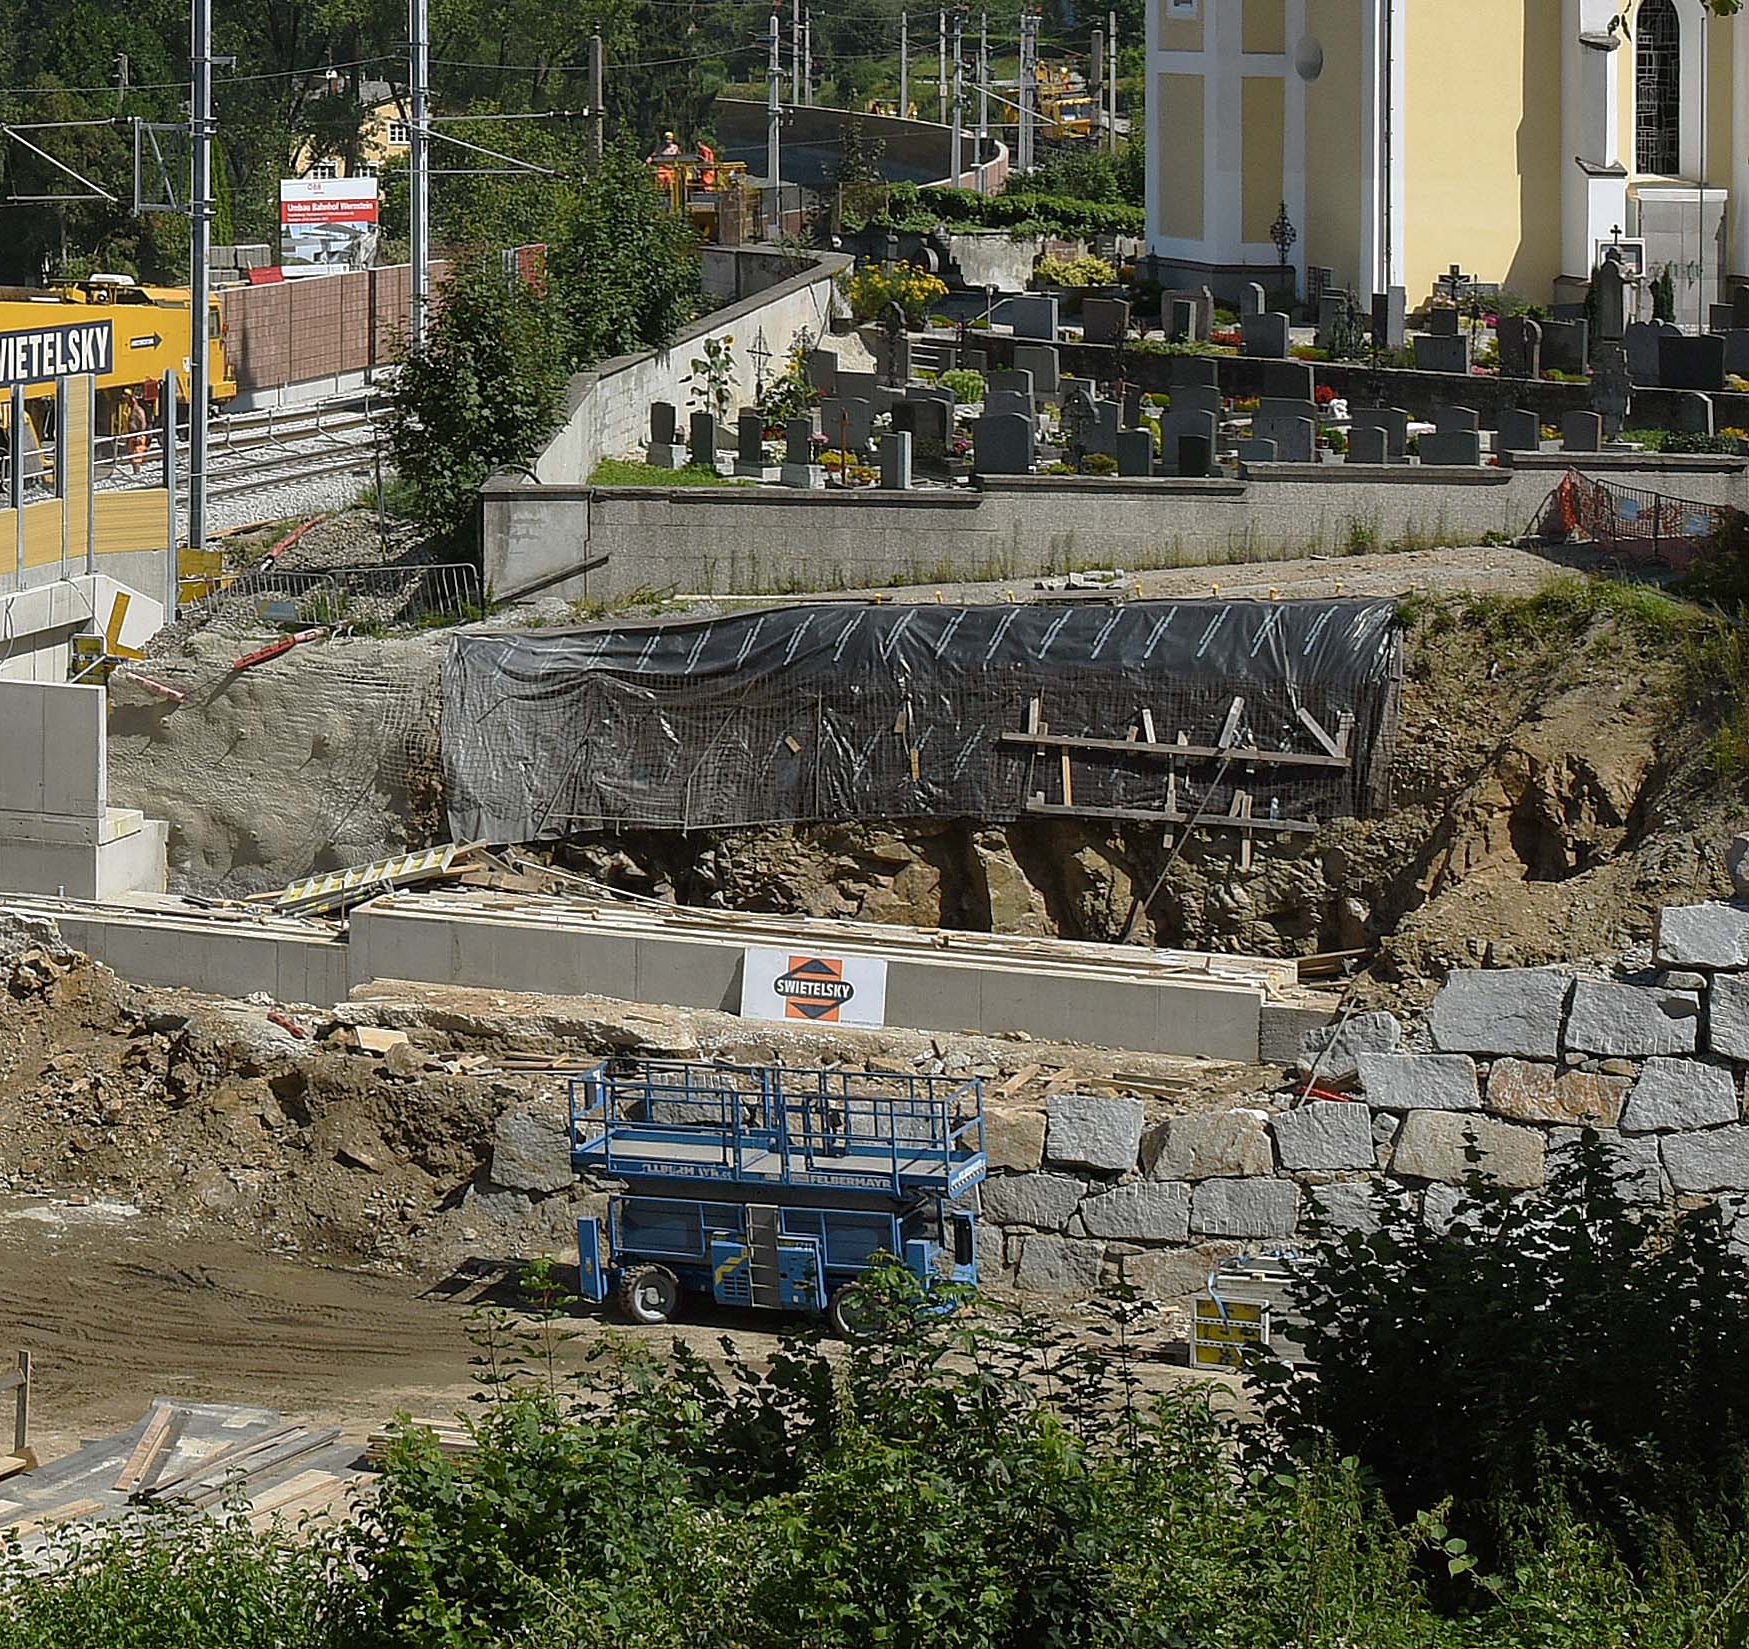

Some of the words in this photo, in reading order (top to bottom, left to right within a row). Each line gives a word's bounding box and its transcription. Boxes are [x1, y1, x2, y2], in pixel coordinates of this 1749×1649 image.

[287, 203, 310, 212] Umbau
[312, 202, 339, 211] Bahnhof
[776, 979, 850, 998] SWIETELSKY
[810, 1174, 892, 1188] FELBERMAYR
